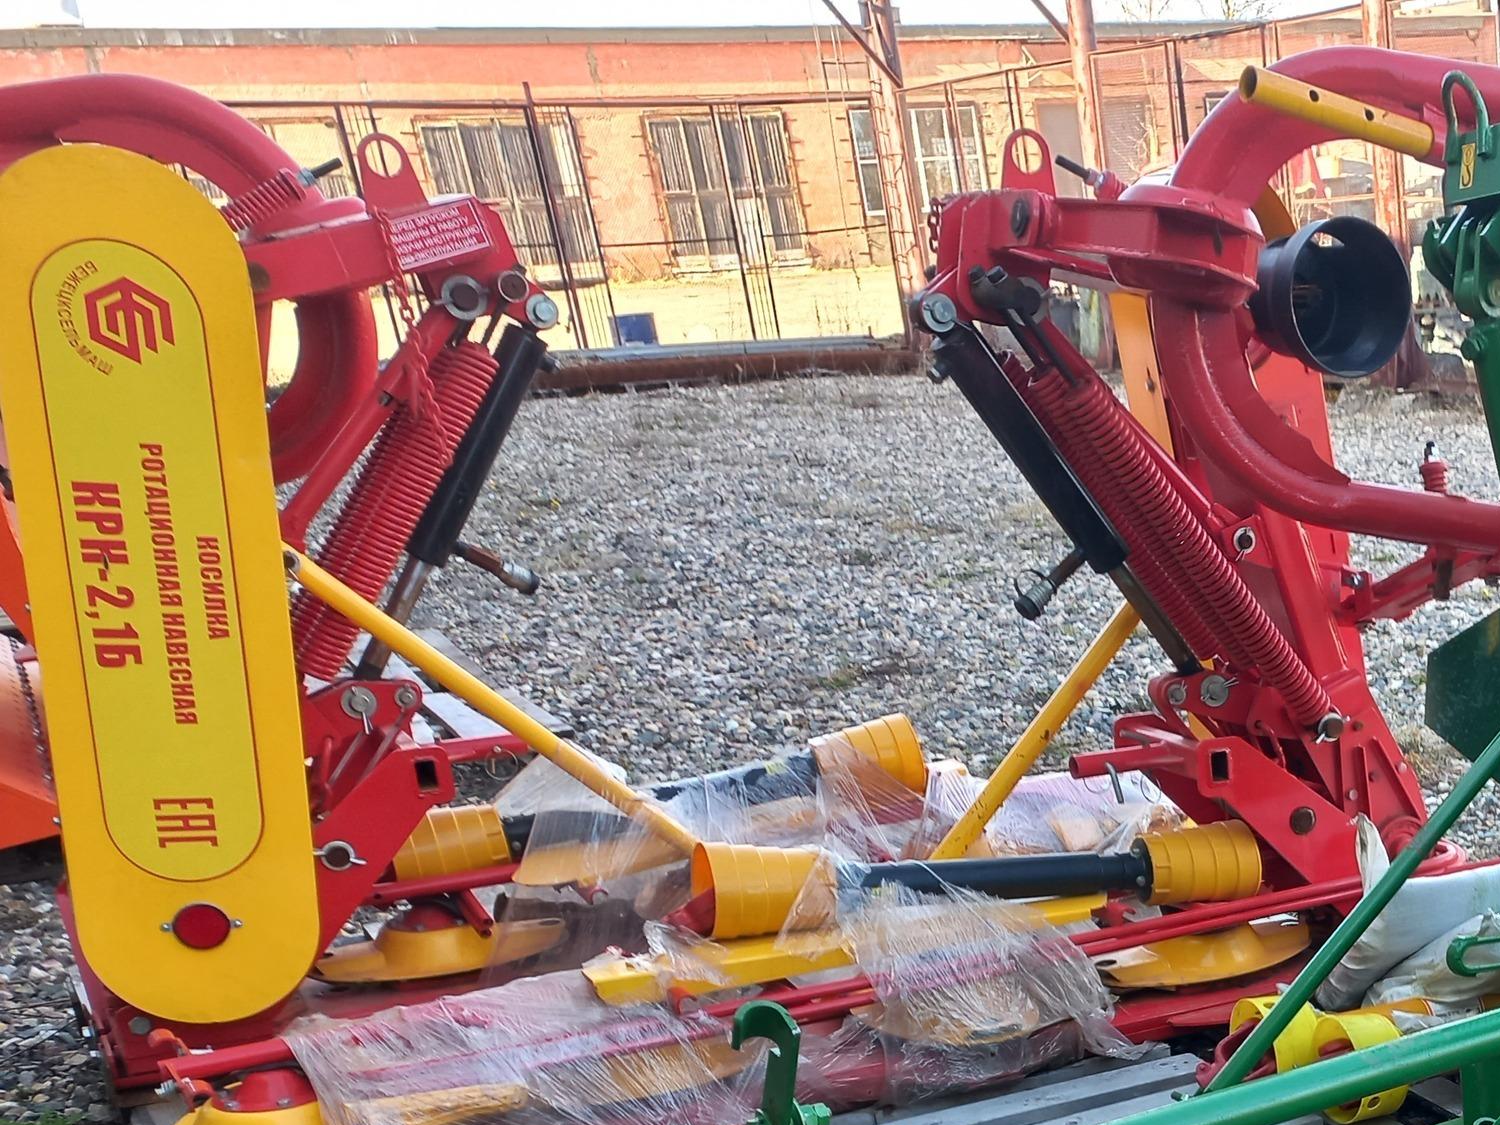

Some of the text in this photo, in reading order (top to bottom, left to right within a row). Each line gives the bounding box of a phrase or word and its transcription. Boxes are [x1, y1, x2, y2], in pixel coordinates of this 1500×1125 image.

[71, 480, 143, 668] КРН-2,1Б
[139, 443, 199, 725] РОТАЦИОННАЯ НАВЕСНАЯ
[196, 536, 231, 640] КОСИЛКА
